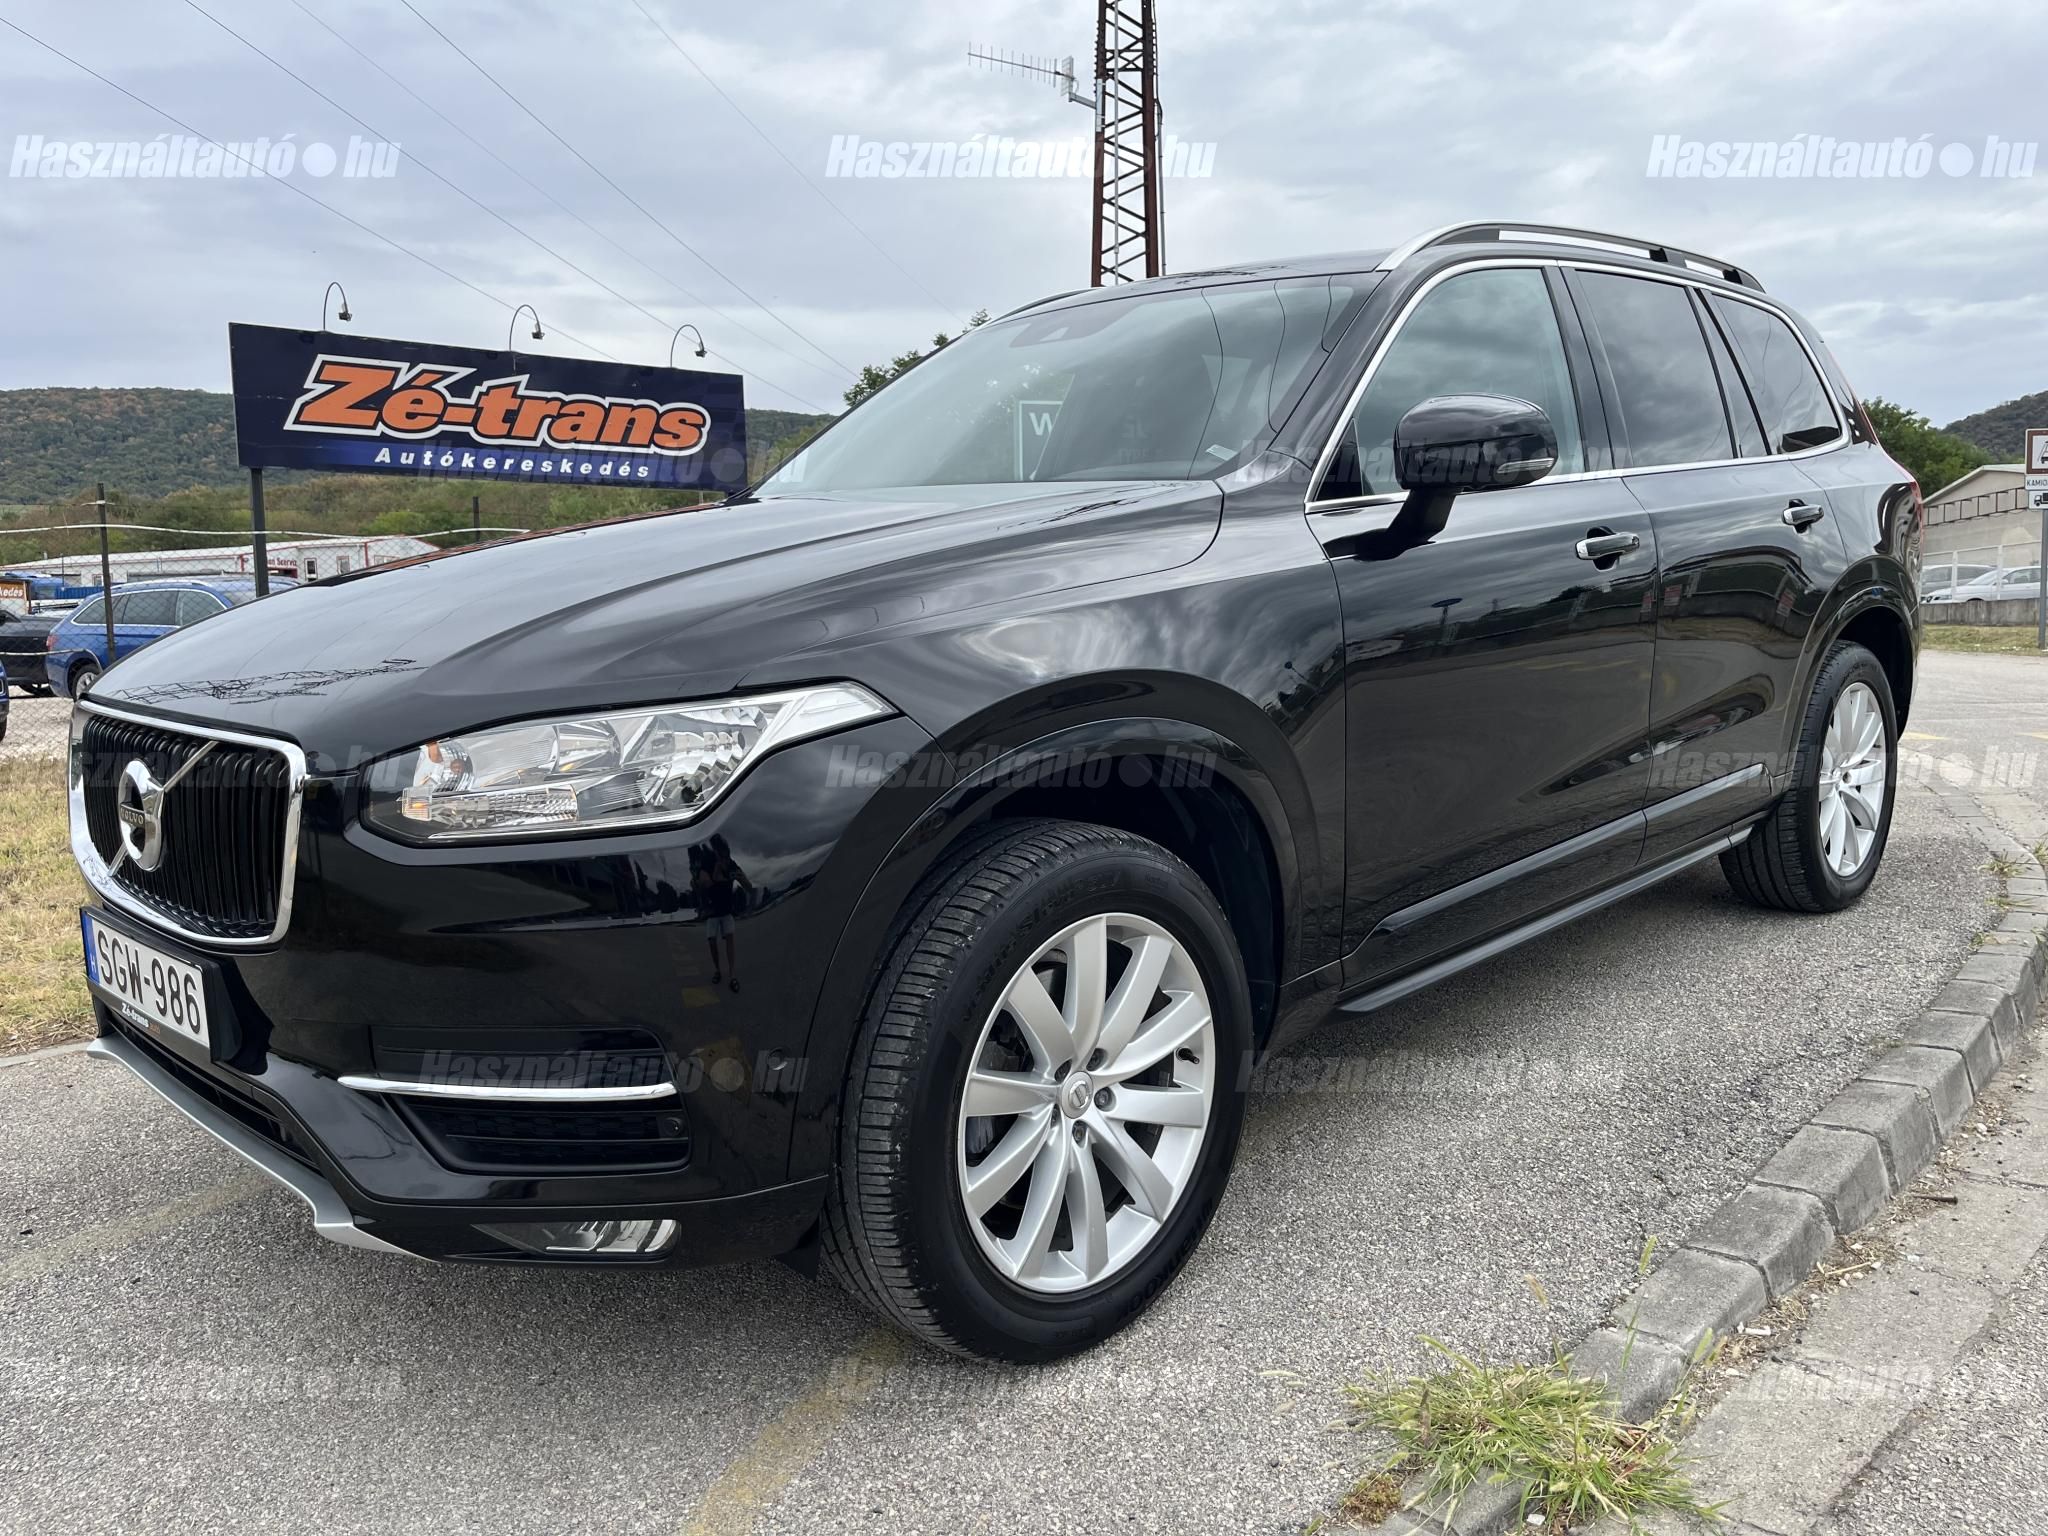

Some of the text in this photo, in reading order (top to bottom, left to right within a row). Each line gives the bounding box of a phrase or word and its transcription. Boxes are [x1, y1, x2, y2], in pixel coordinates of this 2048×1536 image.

[290, 358, 708, 453] Zé-trans
[374, 447, 650, 477] Autókereskedés
[120, 806, 144, 825] VOLVO
[97, 929, 201, 1034] SGW-986
